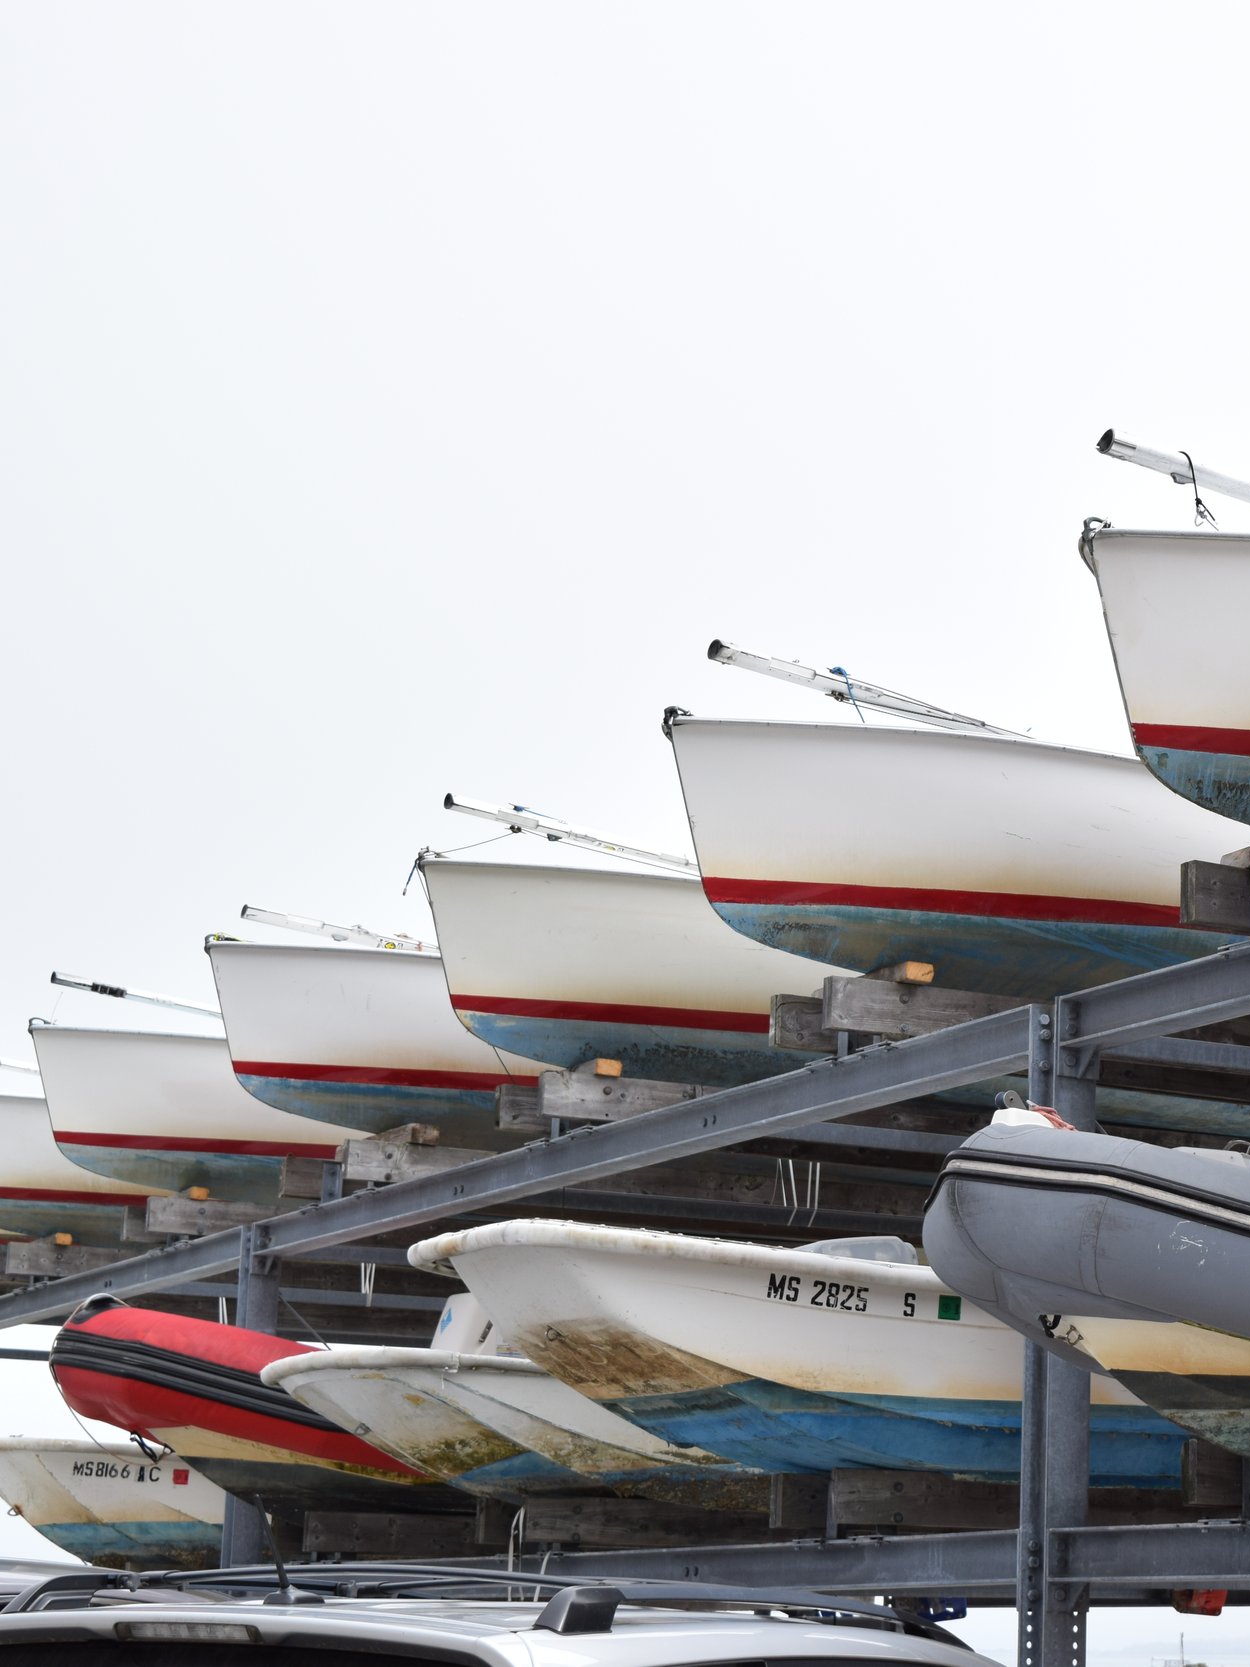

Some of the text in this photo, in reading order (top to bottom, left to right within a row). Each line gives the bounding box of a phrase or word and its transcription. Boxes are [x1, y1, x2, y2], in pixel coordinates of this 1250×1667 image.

[766, 1272, 801, 1303] MS
[810, 1279, 869, 1313] 2825
[903, 1292, 916, 1318] S
